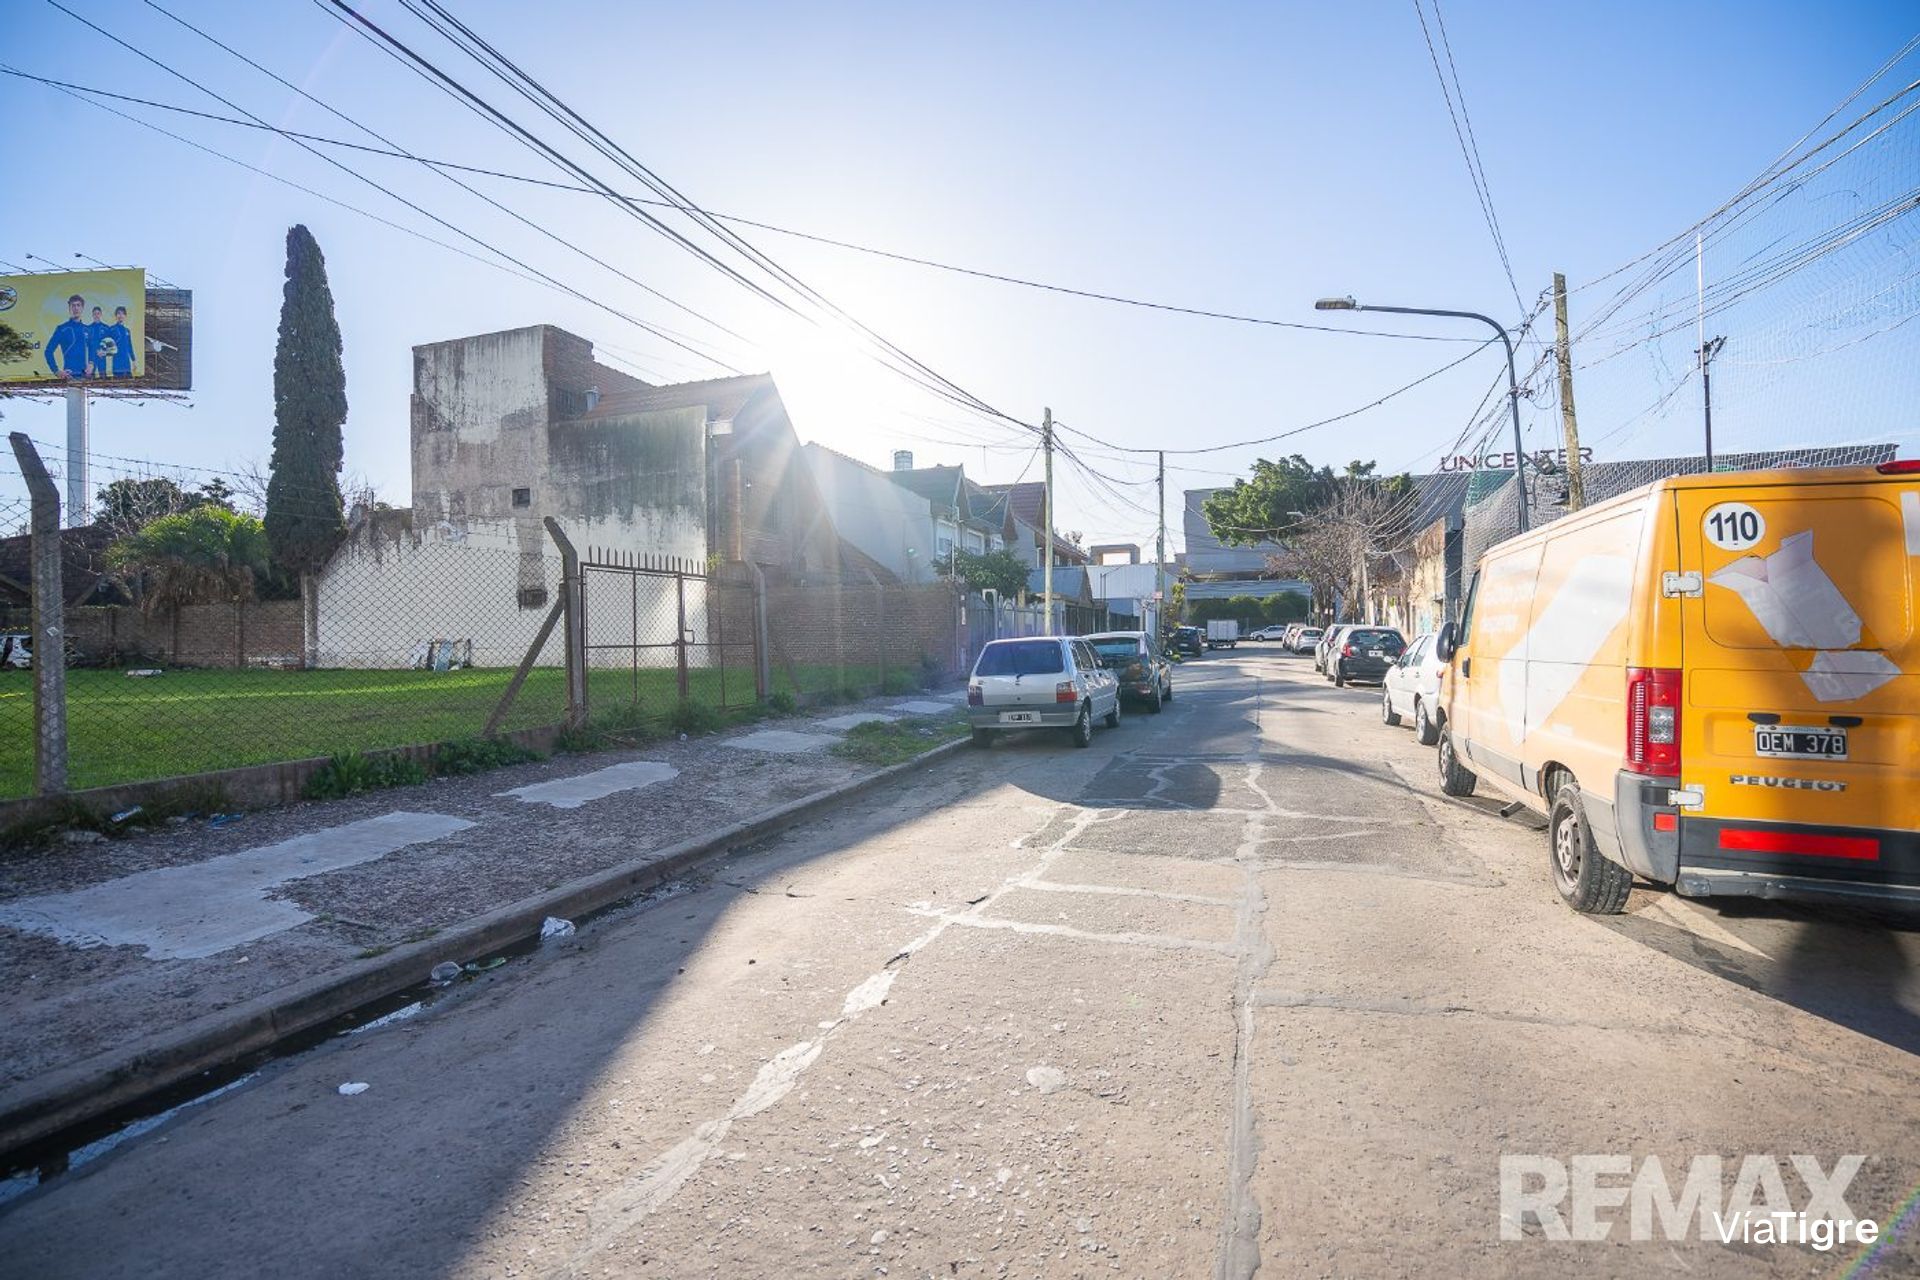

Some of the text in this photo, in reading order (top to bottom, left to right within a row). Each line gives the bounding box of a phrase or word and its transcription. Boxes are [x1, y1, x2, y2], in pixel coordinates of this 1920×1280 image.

[1440, 447, 1593, 472] UNICENTER
[1710, 511, 1758, 541] 110
[1806, 735, 1844, 753] 378
[1730, 774, 1848, 791] PEUGEOT
